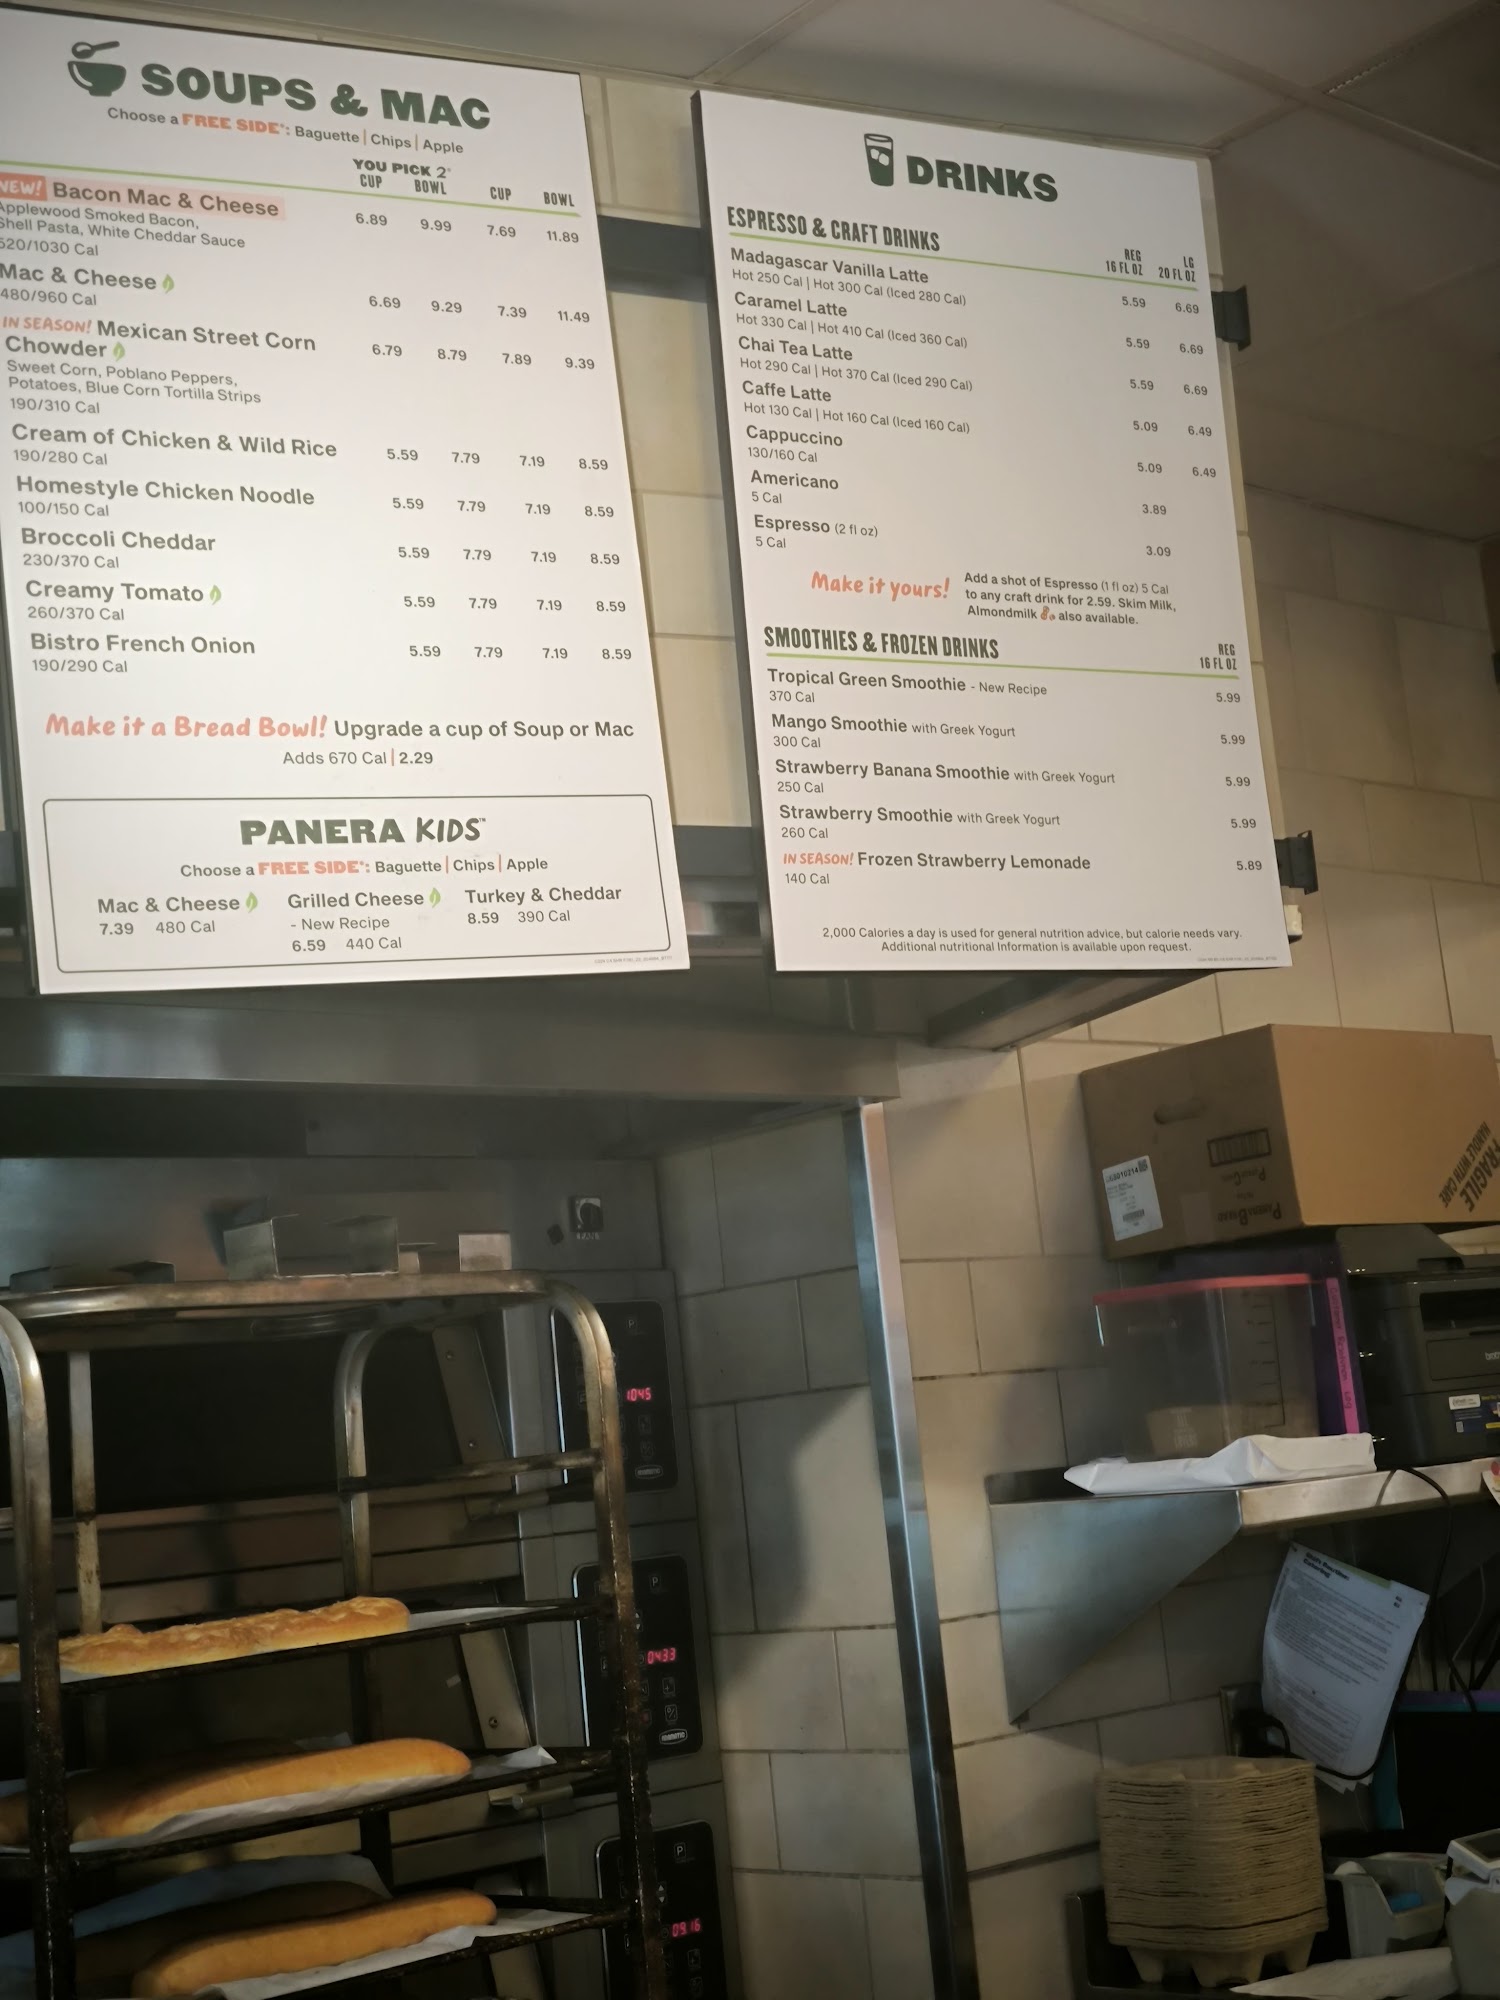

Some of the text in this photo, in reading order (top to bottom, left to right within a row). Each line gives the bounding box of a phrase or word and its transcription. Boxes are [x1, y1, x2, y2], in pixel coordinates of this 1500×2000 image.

[140, 63, 491, 130] SOUPS & MAC
[0, 180, 42, 197] NEW!
[359, 173, 575, 208] CUP BOWL CUP BOWL
[906, 155, 1059, 203] DRINKS
[52, 181, 279, 217] Bacon Mac & Cheese
[84, 207, 145, 224] Smoked
[148, 212, 199, 230] Bacon,
[355, 212, 580, 244] 6.89 9.99 7.69 11.89
[726, 205, 941, 252] ESPRESSO & CRAFT DRINKS
[36, 219, 84, 237] Pasta,
[87, 223, 130, 239] White
[133, 227, 197, 244] Cheddar
[200, 232, 246, 249] Sauce
[730, 247, 929, 284] Madagascar Vanilla Latte
[1124, 248, 1142, 262] REG
[0, 262, 157, 291] Mac & Cheese
[1105, 260, 1144, 276] 16 FL OZ
[0, 287, 97, 306] 480/960 Cal
[734, 291, 848, 318] Caramel Latte
[2, 315, 93, 334] IN SEASON!
[97, 319, 316, 351] Mexican Street Corn
[5, 335, 108, 358] Chowder
[371, 343, 595, 370] 6.79 8.79 7.89 9.39
[738, 335, 853, 361] Chai Tea Latte
[11, 423, 337, 457] Cream of Chicken & Wild Rice
[746, 424, 843, 447] Cappuccino
[747, 446, 818, 463] 130/160 Cal
[16, 475, 315, 506] Homestyle Chicken Noodle
[750, 469, 839, 490] Americano
[1142, 503, 1167, 516] 3.89
[754, 514, 878, 538] Espresso (2 fl oz)
[21, 527, 216, 551] Broccoli Cheddar
[25, 579, 204, 603] Creamy Tomato
[811, 570, 950, 602] Make it yours!
[30, 632, 255, 654] Bistro French Onion
[763, 625, 999, 660] SMOOTHIES & FROZEN DRINKS
[45, 713, 328, 738] Make it a Bread Bowl!
[334, 720, 634, 741] Upgrade a cup of Soup or Mac
[771, 713, 1016, 739] Mango Smoothie with Greek Yogurt
[1220, 734, 1246, 745] 5.99
[239, 818, 406, 846] PANERA
[857, 851, 1091, 872] Frozen Strawberry Lemonade
[1236, 860, 1263, 871] 5.89
[287, 891, 425, 909] Grilled Cheese
[464, 886, 622, 906] Turkey & Cheddar
[822, 927, 1242, 941] 2,000 Calories a day is used for general nutrition advice, but calorie needs vary.
